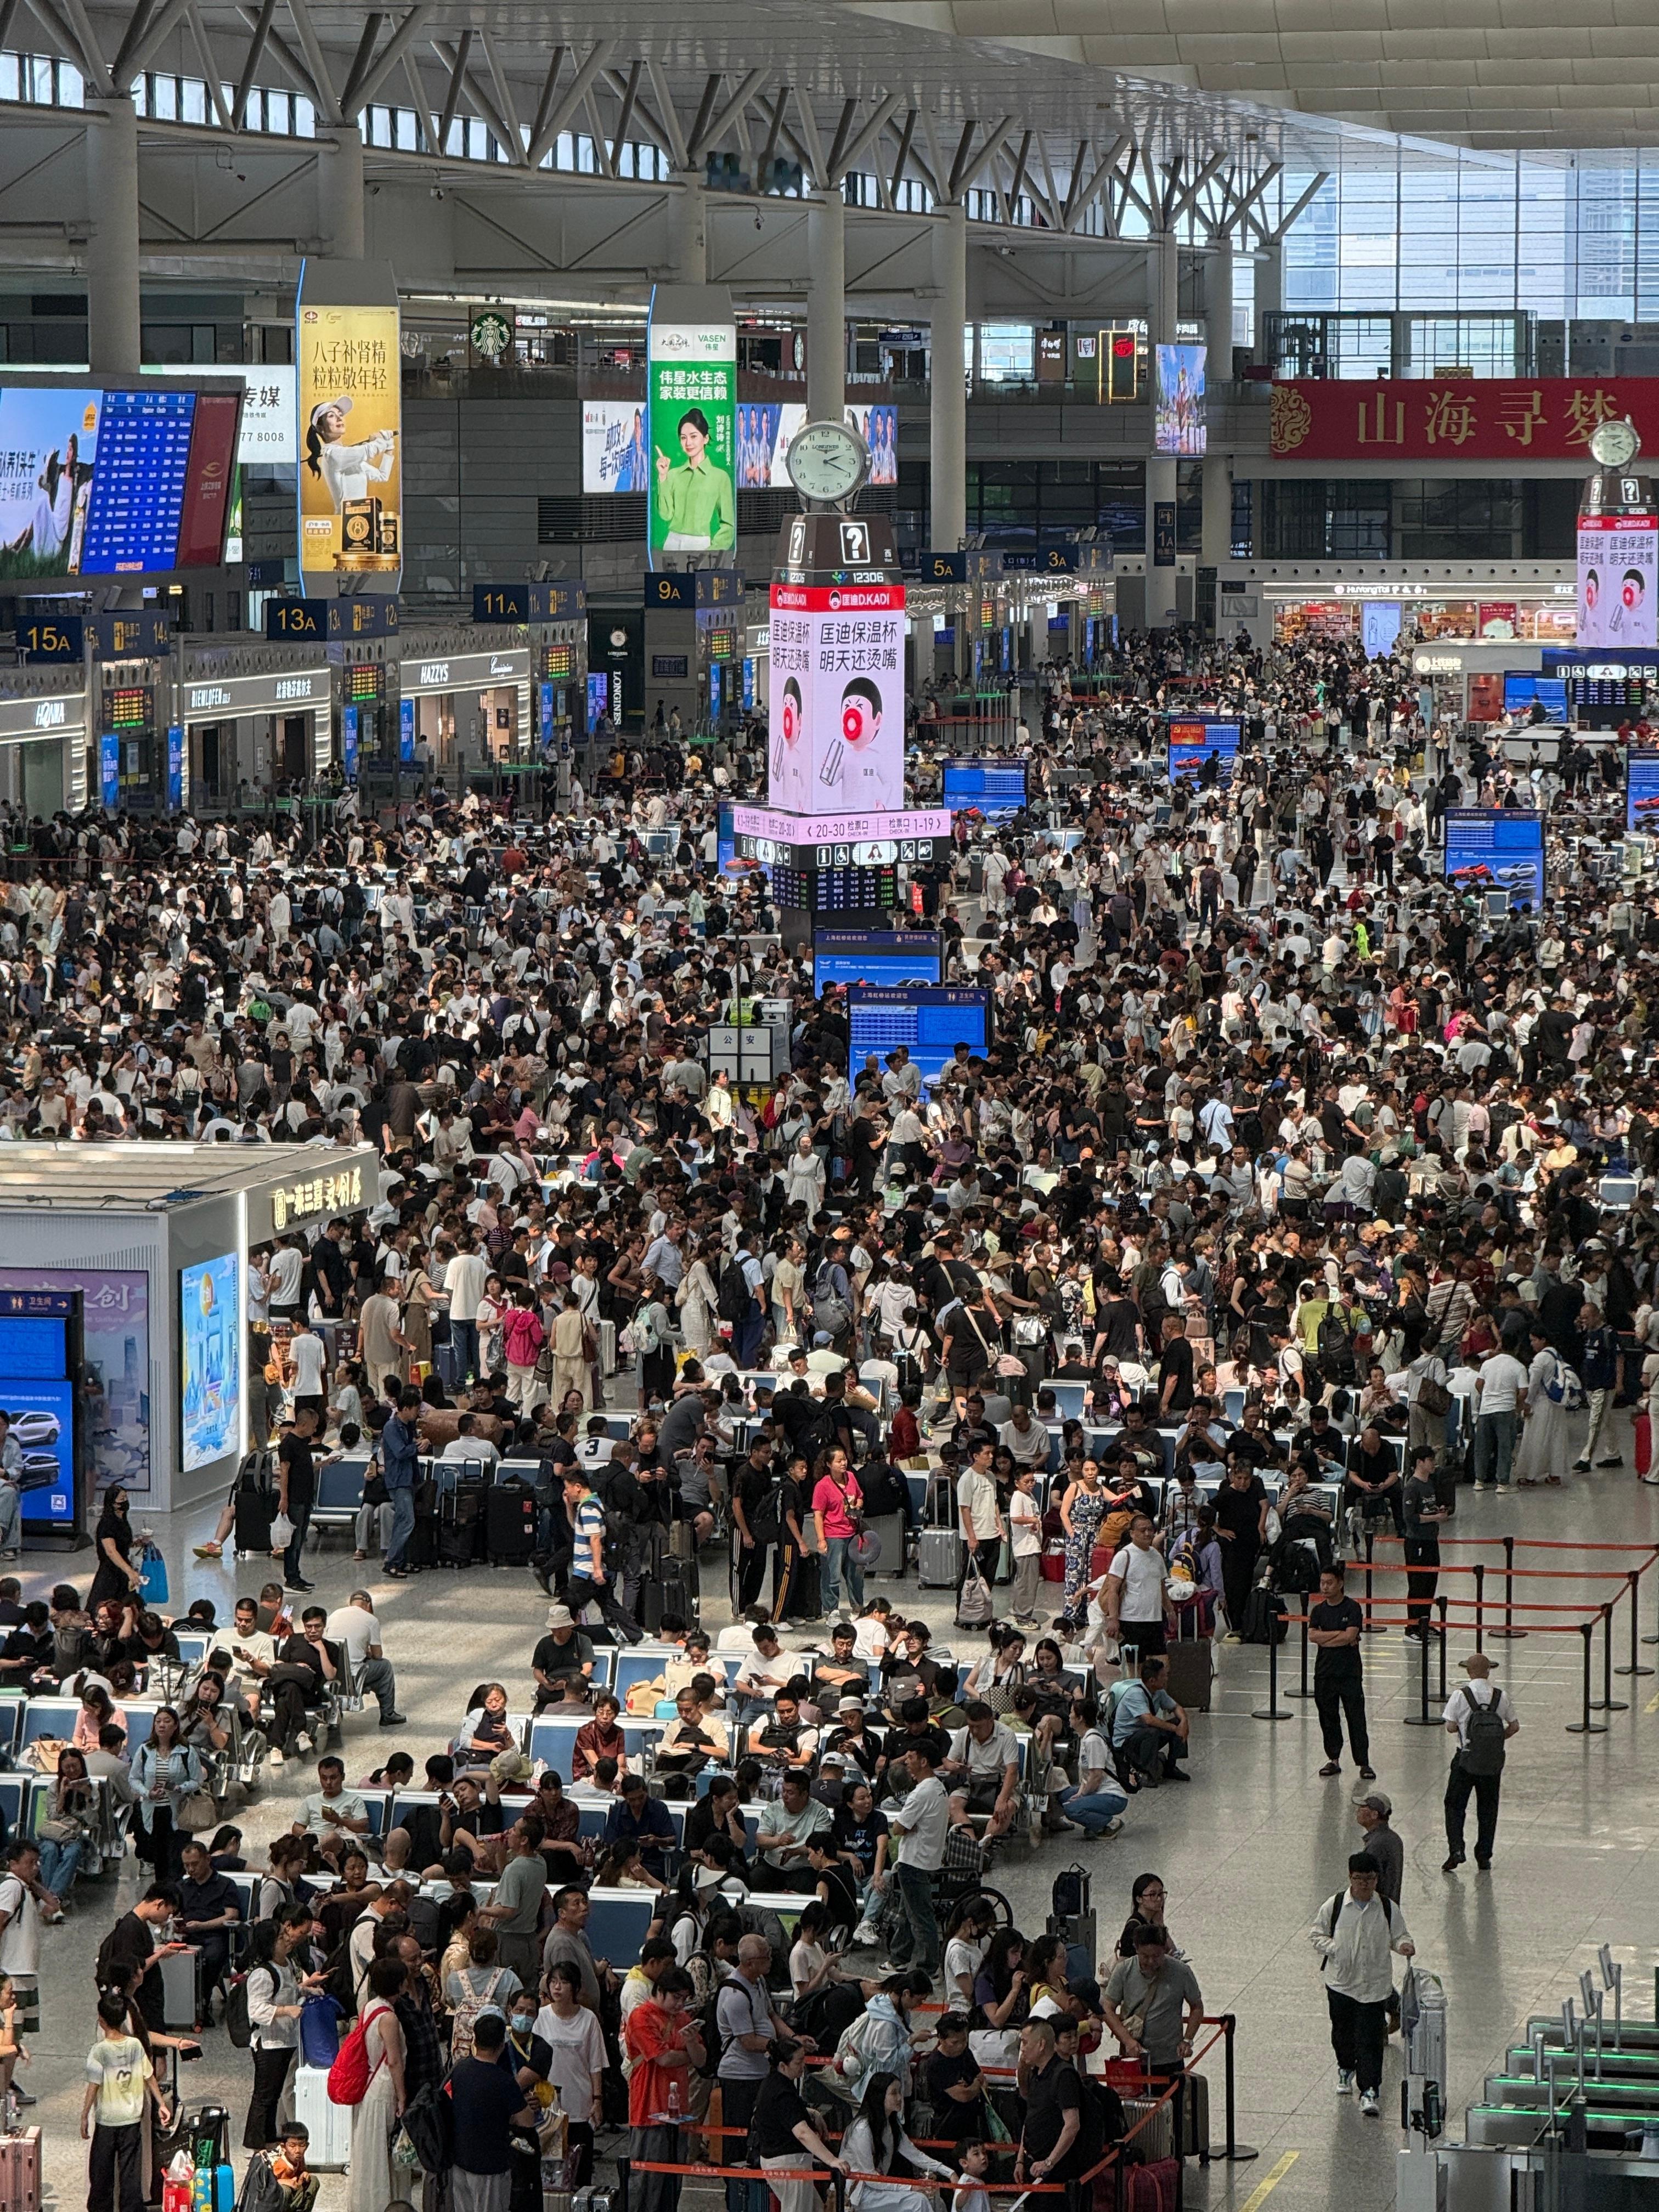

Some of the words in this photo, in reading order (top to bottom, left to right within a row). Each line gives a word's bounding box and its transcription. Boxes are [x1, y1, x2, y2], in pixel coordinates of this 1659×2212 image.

[313, 340, 386, 364] 八子补肾精
[313, 366, 387, 390] 粒粒敬年轻
[659, 371, 727, 385] 伟星水生态
[660, 386, 727, 400] 家装更信赖
[1358, 390, 1617, 445] 山海寻梦
[257, 432, 284, 442] 8008
[1159, 531, 1173, 547] 1A
[934, 560, 953, 576] 5A
[1048, 551, 1066, 567] 3A
[790, 572, 805, 583] 12306
[853, 572, 884, 583] 12306
[658, 581, 680, 599] 9A
[484, 594, 517, 614] 11A
[842, 593, 890, 606] 匡迪D.KADI
[278, 608, 317, 630] 13A
[329, 609, 341, 630] 13A
[385, 604, 397, 625] 12A
[27, 627, 70, 651] 15A
[153, 621, 167, 645] 14A
[774, 619, 810, 644] 匡迪保温杯
[820, 620, 898, 645] 匡迪保温杯
[773, 647, 810, 672] 明天还烫嘴
[820, 647, 898, 673] 明天还烫嘴
[421, 664, 448, 684] HAZZYS
[613, 670, 621, 725] LONGINES
[779, 822, 792, 837] 20-30
[816, 823, 845, 838] 20-30
[848, 820, 868, 831] 检票口
[889, 818, 910, 828] 检票口
[914, 817, 934, 831] 1-19
[724, 1035, 755, 1045] 公安
[29, 1296, 52, 1306] 卫生间
[584, 1438, 600, 1457] 3
